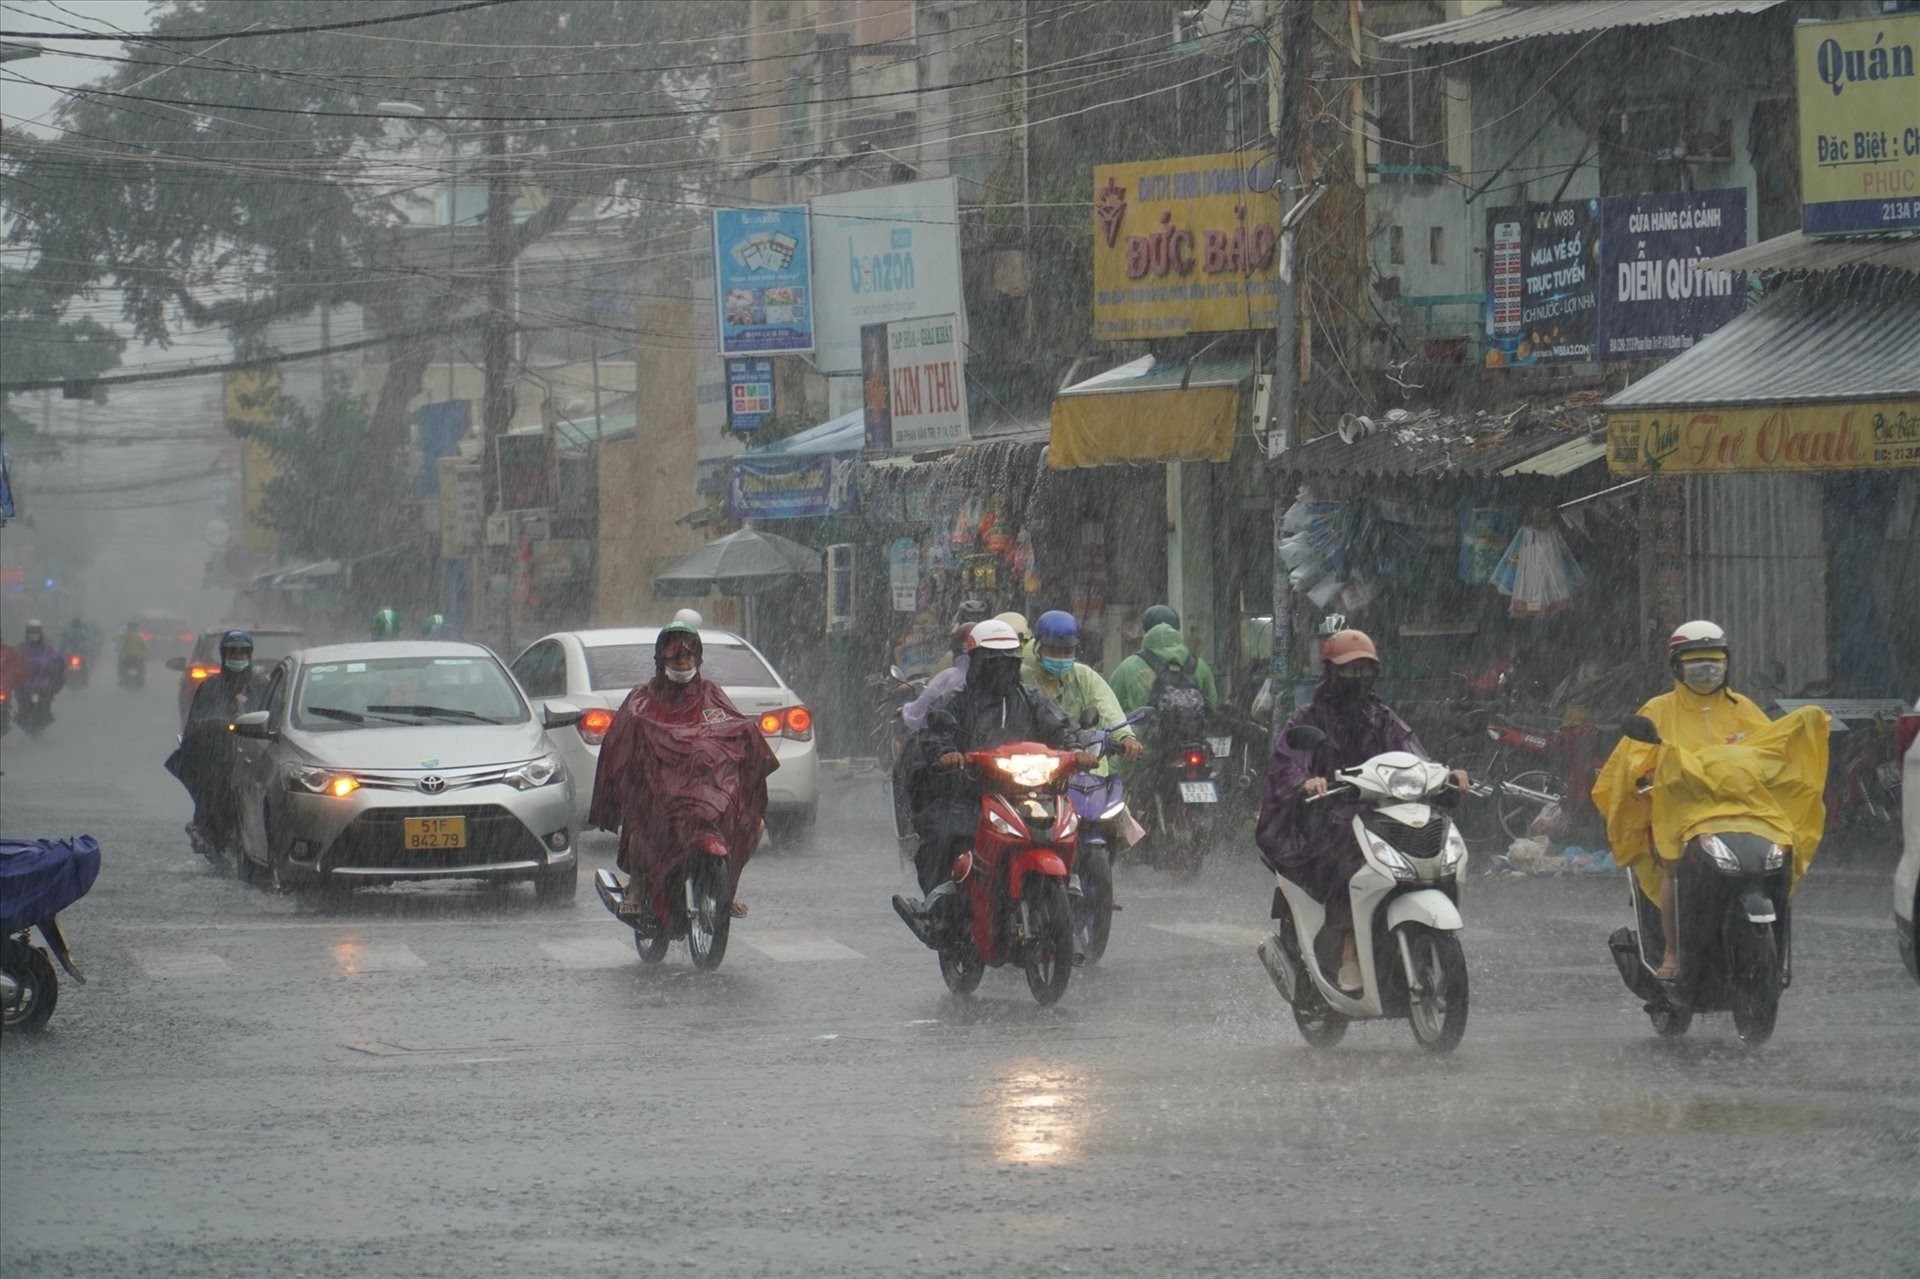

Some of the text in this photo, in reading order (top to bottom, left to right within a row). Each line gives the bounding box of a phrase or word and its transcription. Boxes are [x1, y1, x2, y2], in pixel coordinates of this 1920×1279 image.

[1817, 31, 1915, 96] Quán
[1818, 134, 1848, 168] Đặc
[1854, 131, 1888, 164] Biệt
[1553, 209, 1575, 227] W88
[1629, 202, 1721, 234] CỬA HÀNG CÁ CẢNH
[1882, 202, 1911, 220] 213A
[1125, 203, 1278, 279] ĐỨC BẢO
[1531, 230, 1582, 267] MUA VÉ SỐ
[1527, 257, 1586, 296] TRỰC TUYẾN
[1618, 240, 1733, 302] DIỄM QUỲNH
[893, 364, 923, 417] KIM
[1756, 408, 1865, 465] Oanh
[411, 833, 459, 847] 842.79
[421, 819, 448, 832] 51F
